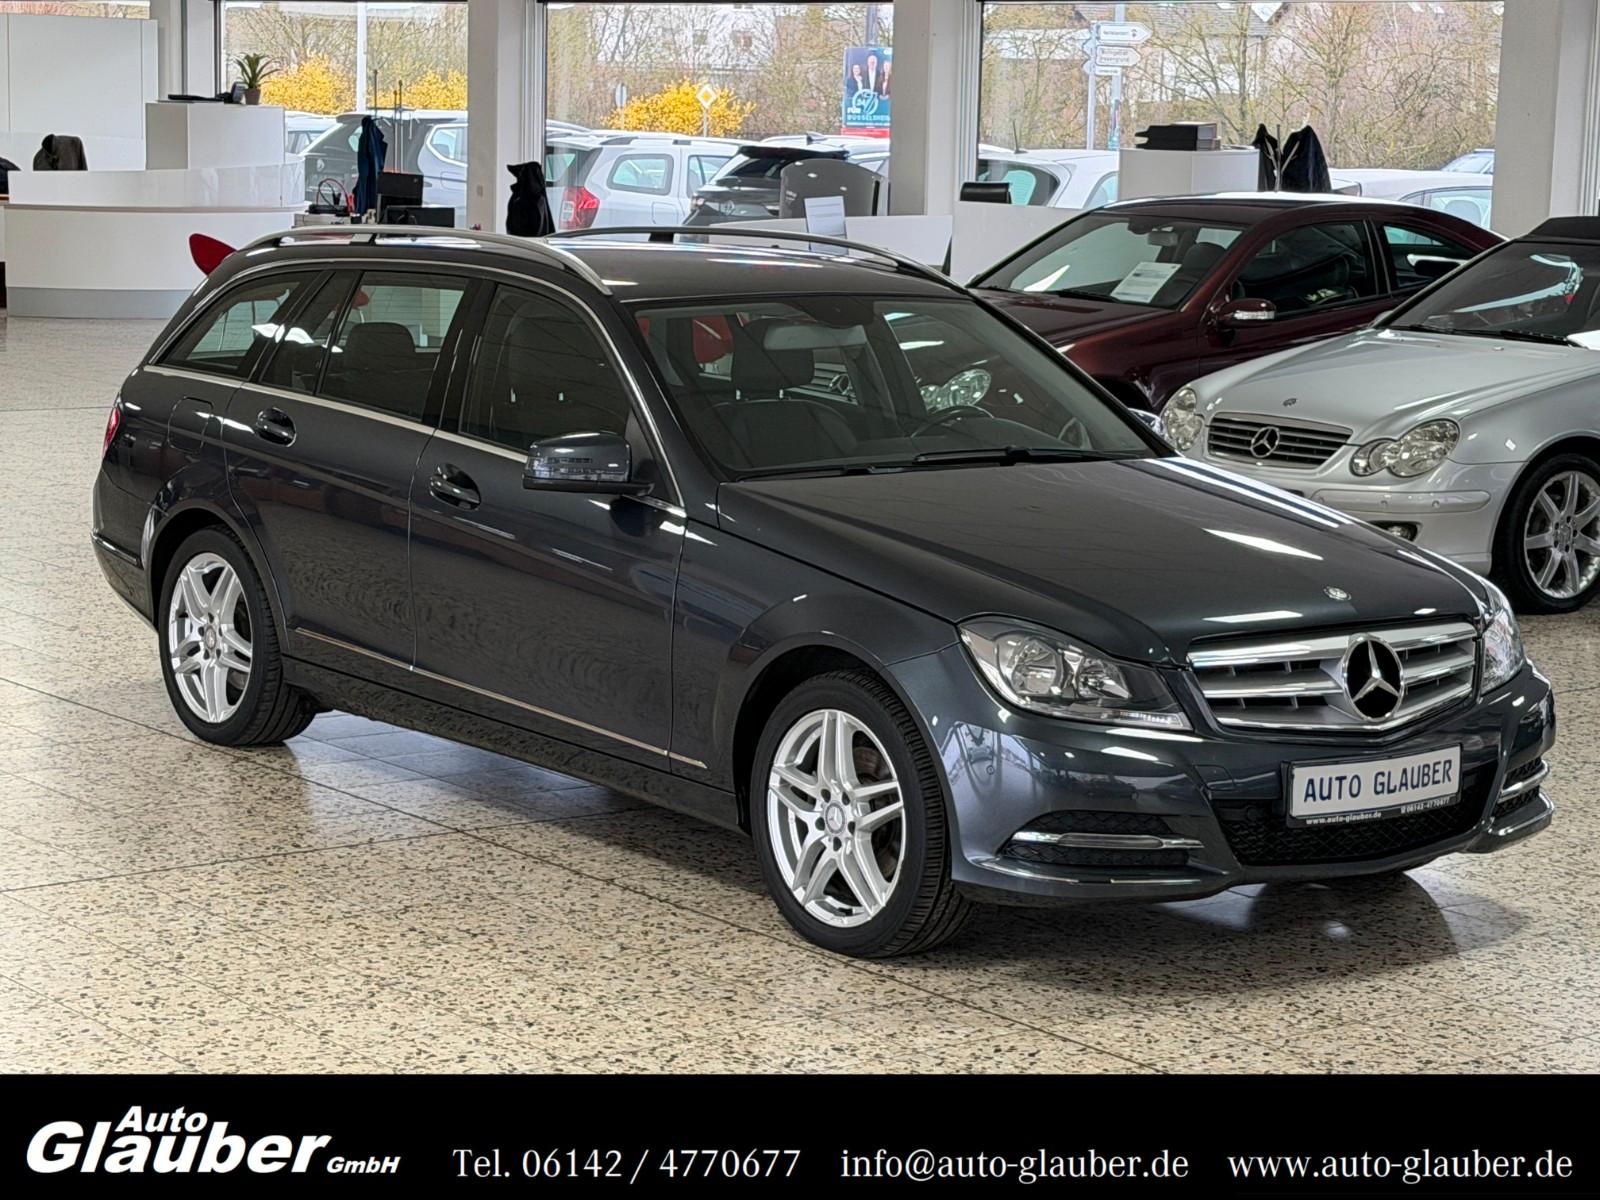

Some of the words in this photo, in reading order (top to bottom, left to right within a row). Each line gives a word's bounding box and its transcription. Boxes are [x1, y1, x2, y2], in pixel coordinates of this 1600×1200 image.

[1303, 774, 1362, 803] AUTO
[1373, 759, 1453, 796] GLAUBER
[1306, 811, 1382, 825] www.auto-glauber.de
